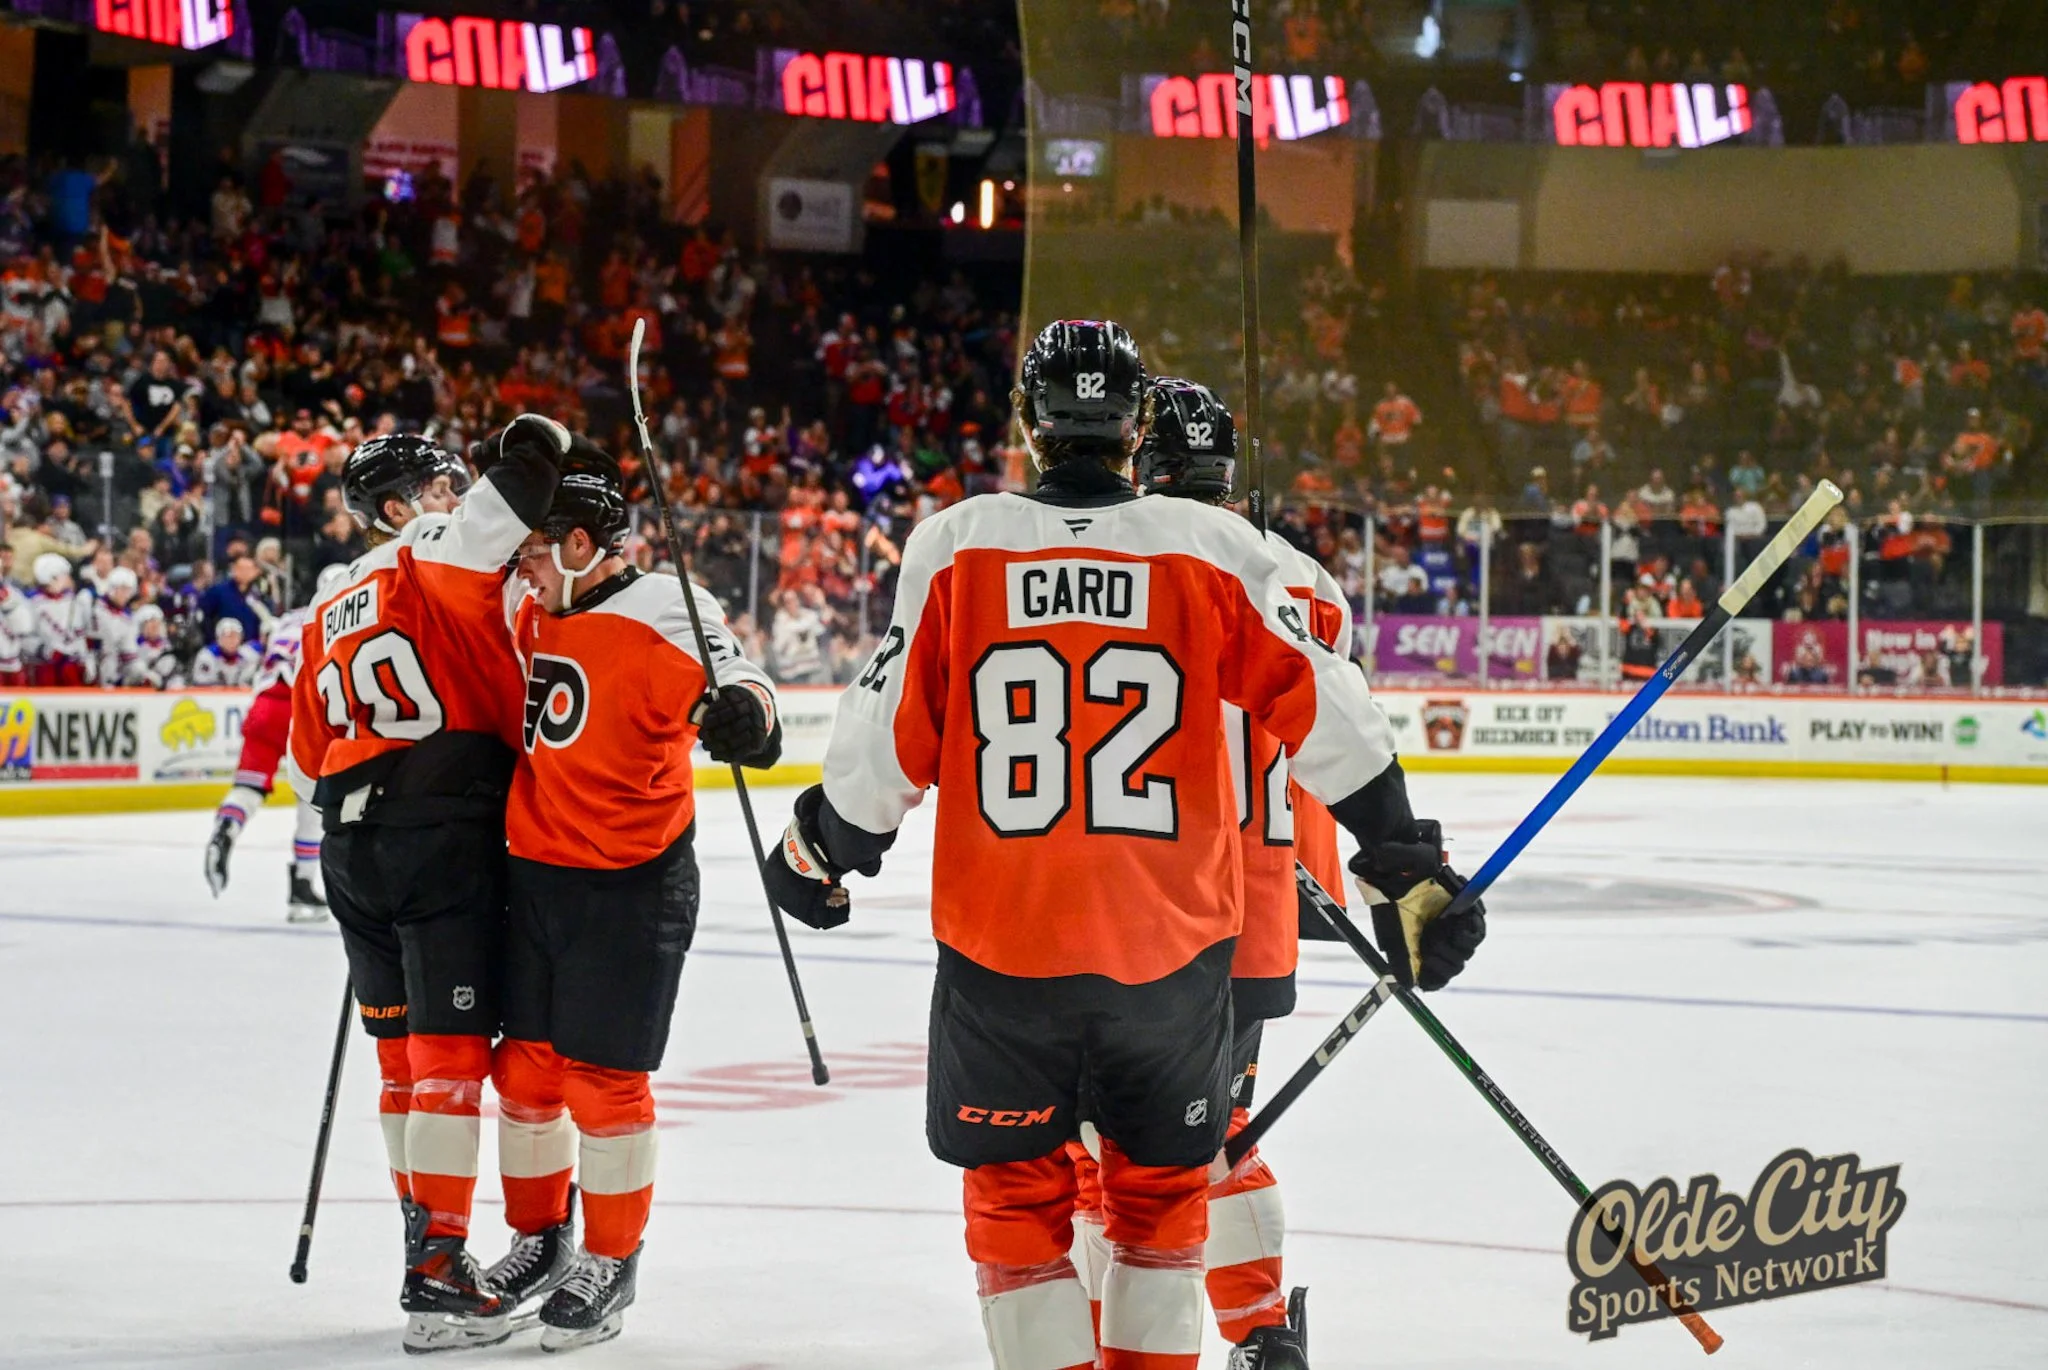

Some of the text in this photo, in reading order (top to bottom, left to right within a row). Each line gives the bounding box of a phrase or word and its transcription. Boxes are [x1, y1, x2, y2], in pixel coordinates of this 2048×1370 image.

[1076, 372, 1106, 399] 82
[1186, 422, 1214, 448] 92
[326, 589, 370, 645] BUMP
[1022, 567, 1133, 619] GARD
[316, 626, 448, 742] 10
[36, 710, 138, 760] NEWS
[969, 639, 1185, 841] 82
[1706, 714, 1788, 743] Bank
[1809, 718, 1866, 743] PLAY
[1890, 720, 1943, 743] WIN!
[955, 1104, 1057, 1127] CCM
[1477, 1071, 1573, 1178] RECHARGE
